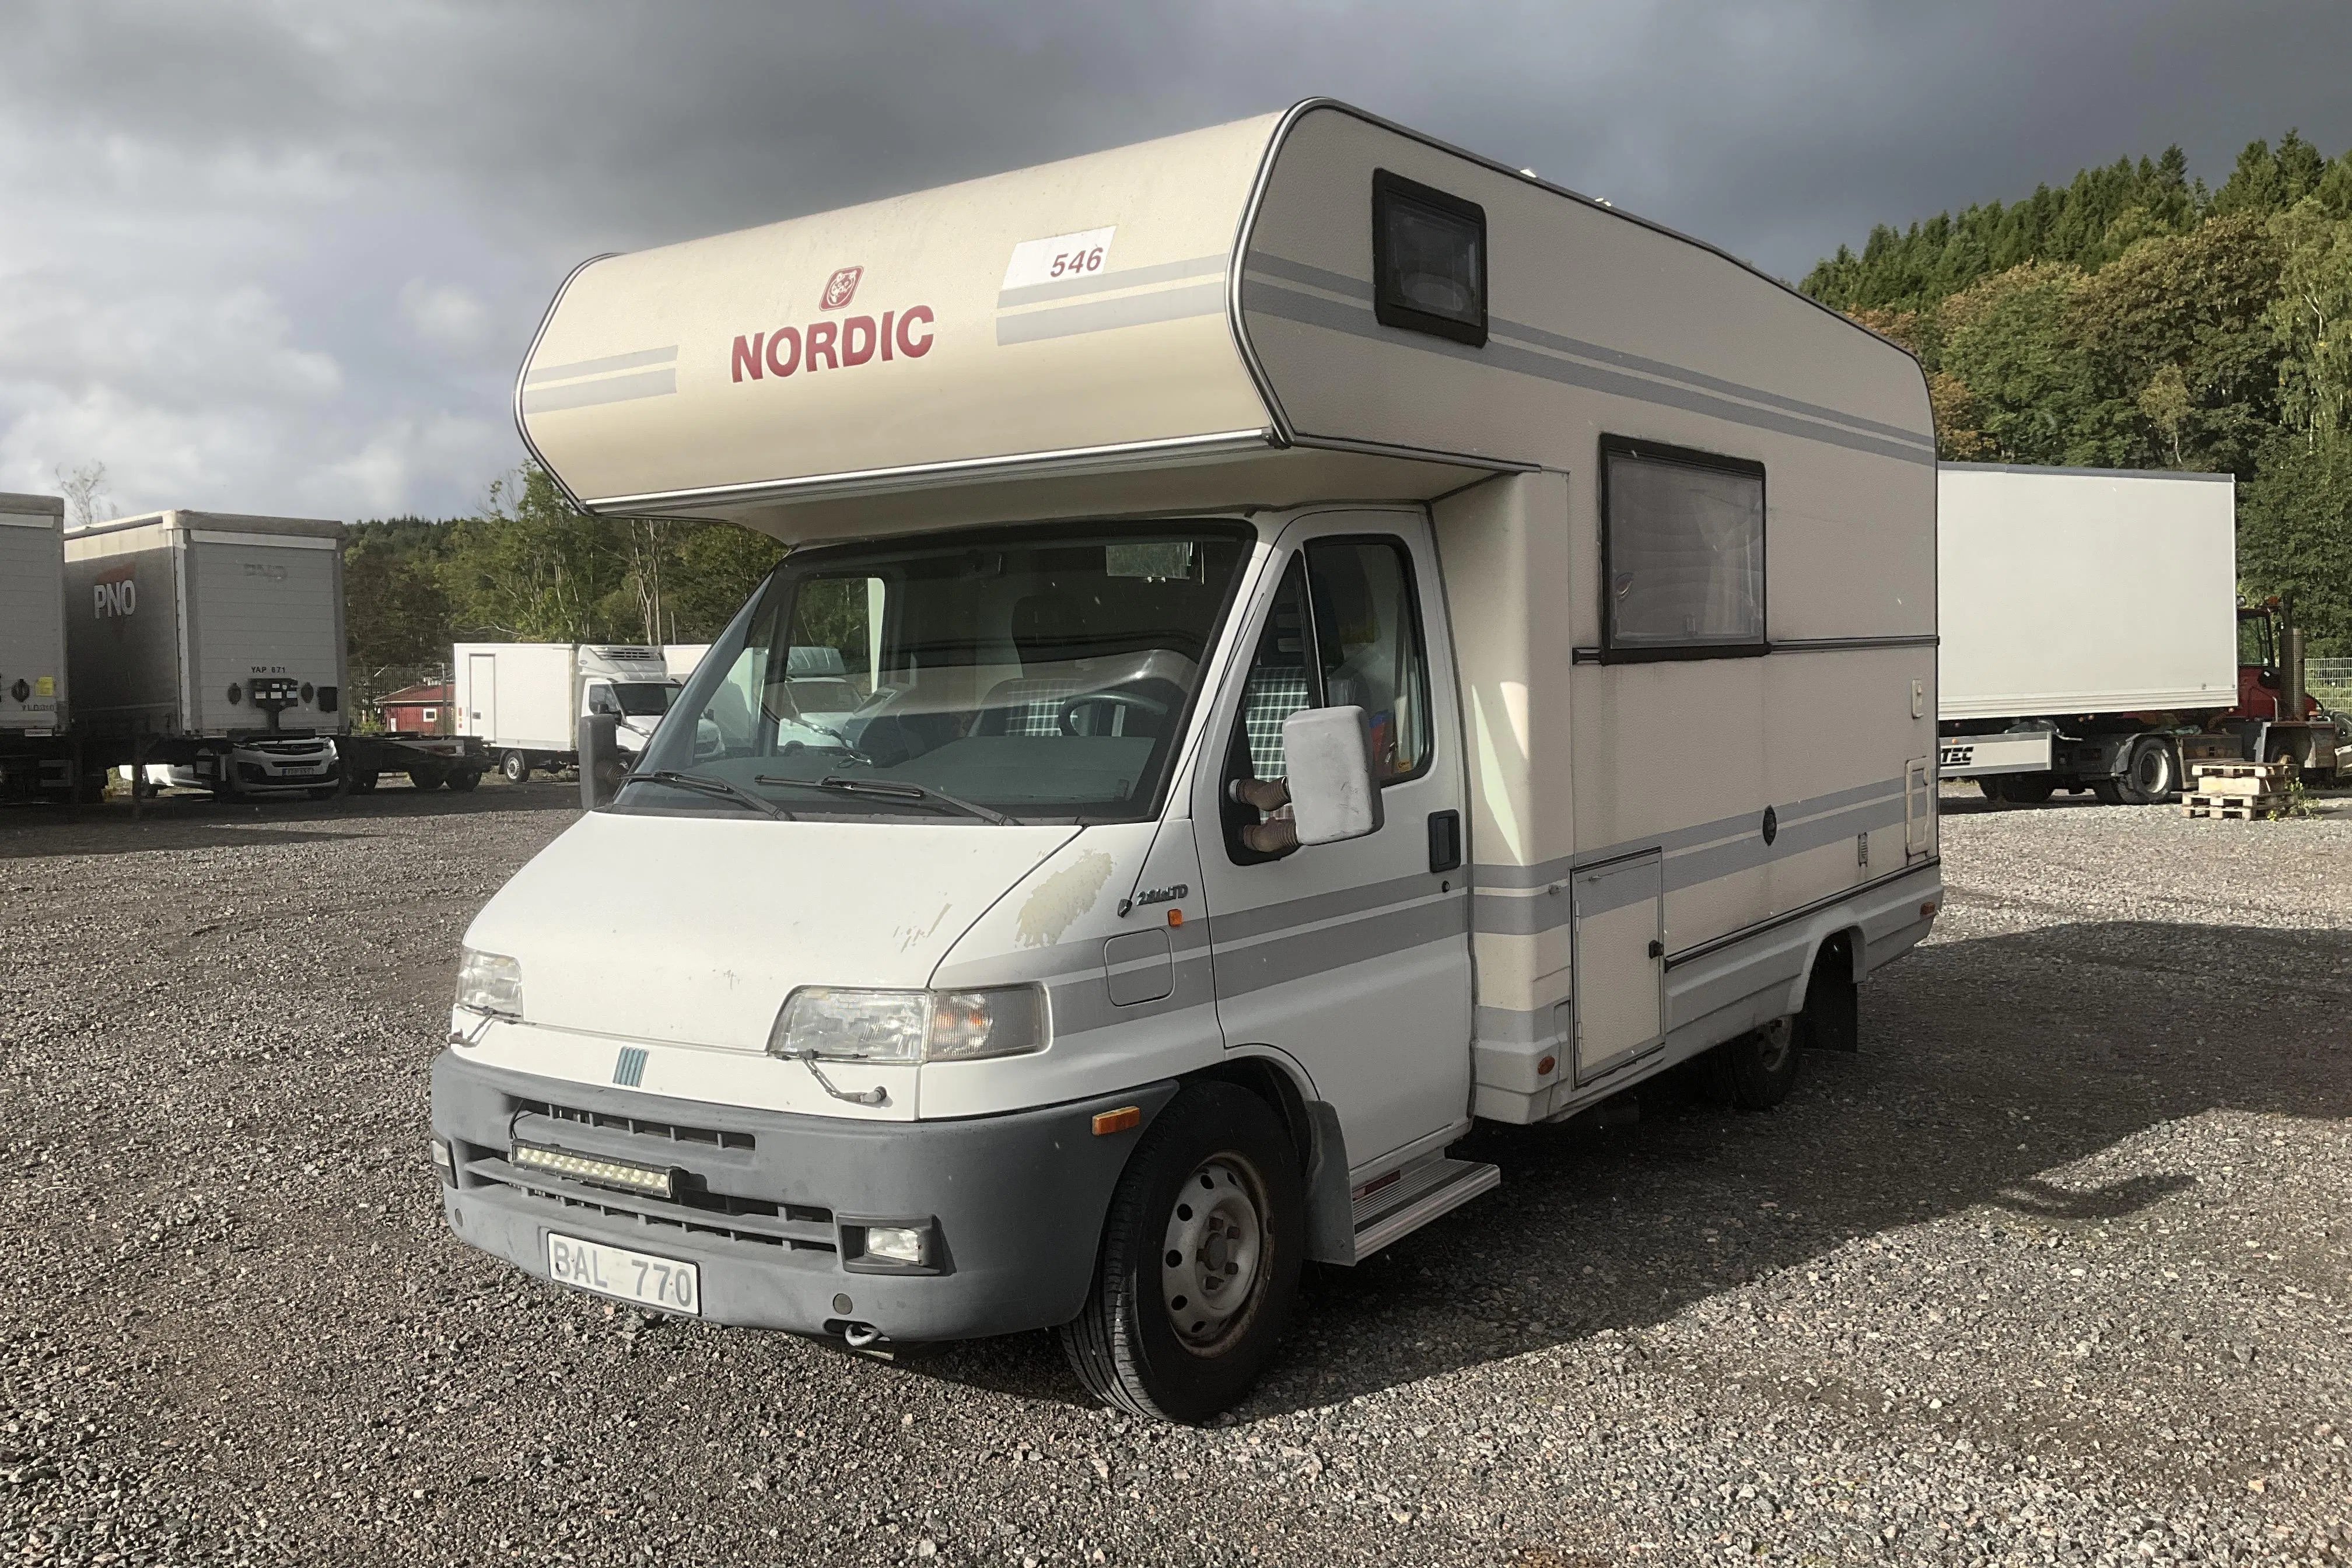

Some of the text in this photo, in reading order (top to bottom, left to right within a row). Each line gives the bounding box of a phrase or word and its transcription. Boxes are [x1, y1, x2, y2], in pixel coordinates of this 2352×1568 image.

[1050, 246, 1104, 278] 546
[732, 304, 935, 383] NORDIC
[93, 579, 136, 619] PNO
[1941, 747, 1974, 763] TEC
[554, 1241, 692, 1307] BAL 770
